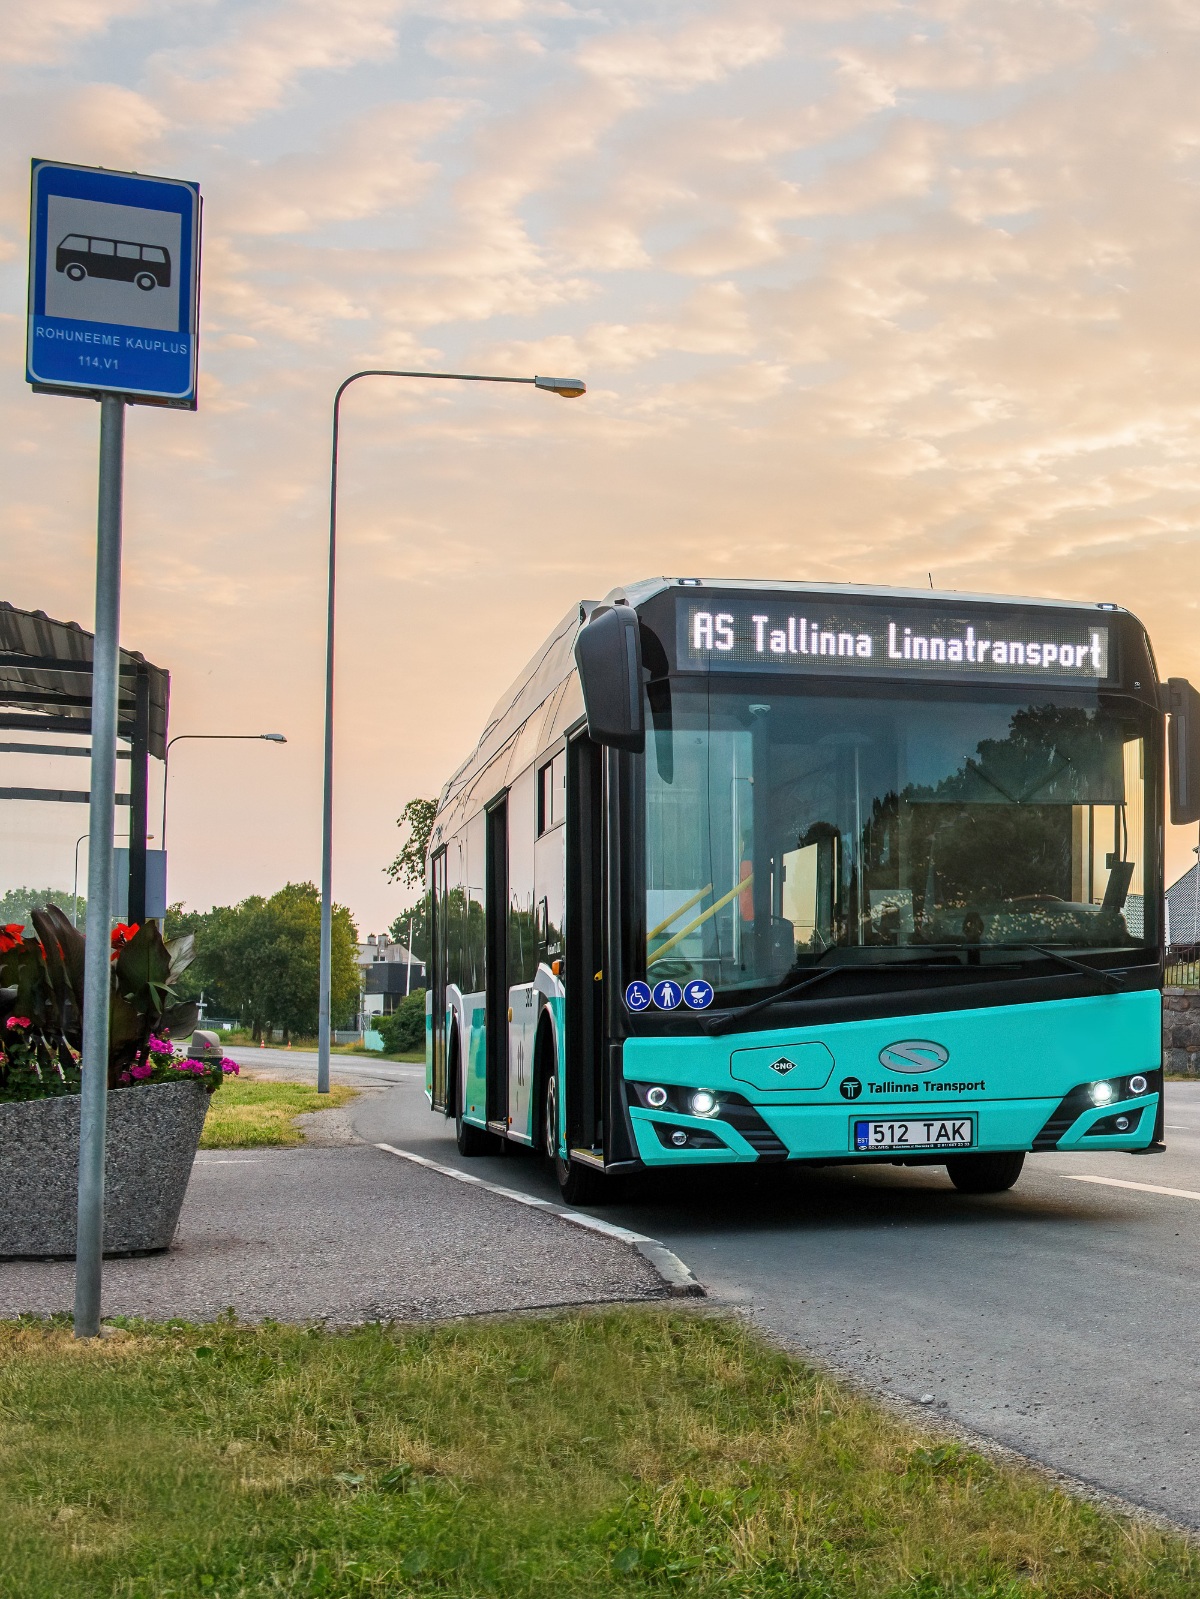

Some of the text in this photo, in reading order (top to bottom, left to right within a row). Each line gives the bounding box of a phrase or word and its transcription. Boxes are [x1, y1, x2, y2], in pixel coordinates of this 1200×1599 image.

[36, 327, 188, 355] ROHUNEEME KAUPLUS
[693, 611, 1101, 669] AS Tallinna Linnatransport
[773, 1062, 793, 1070] CNG
[867, 1080, 986, 1094] Tallinna Transport
[873, 1122, 966, 1143] 512 TAK
